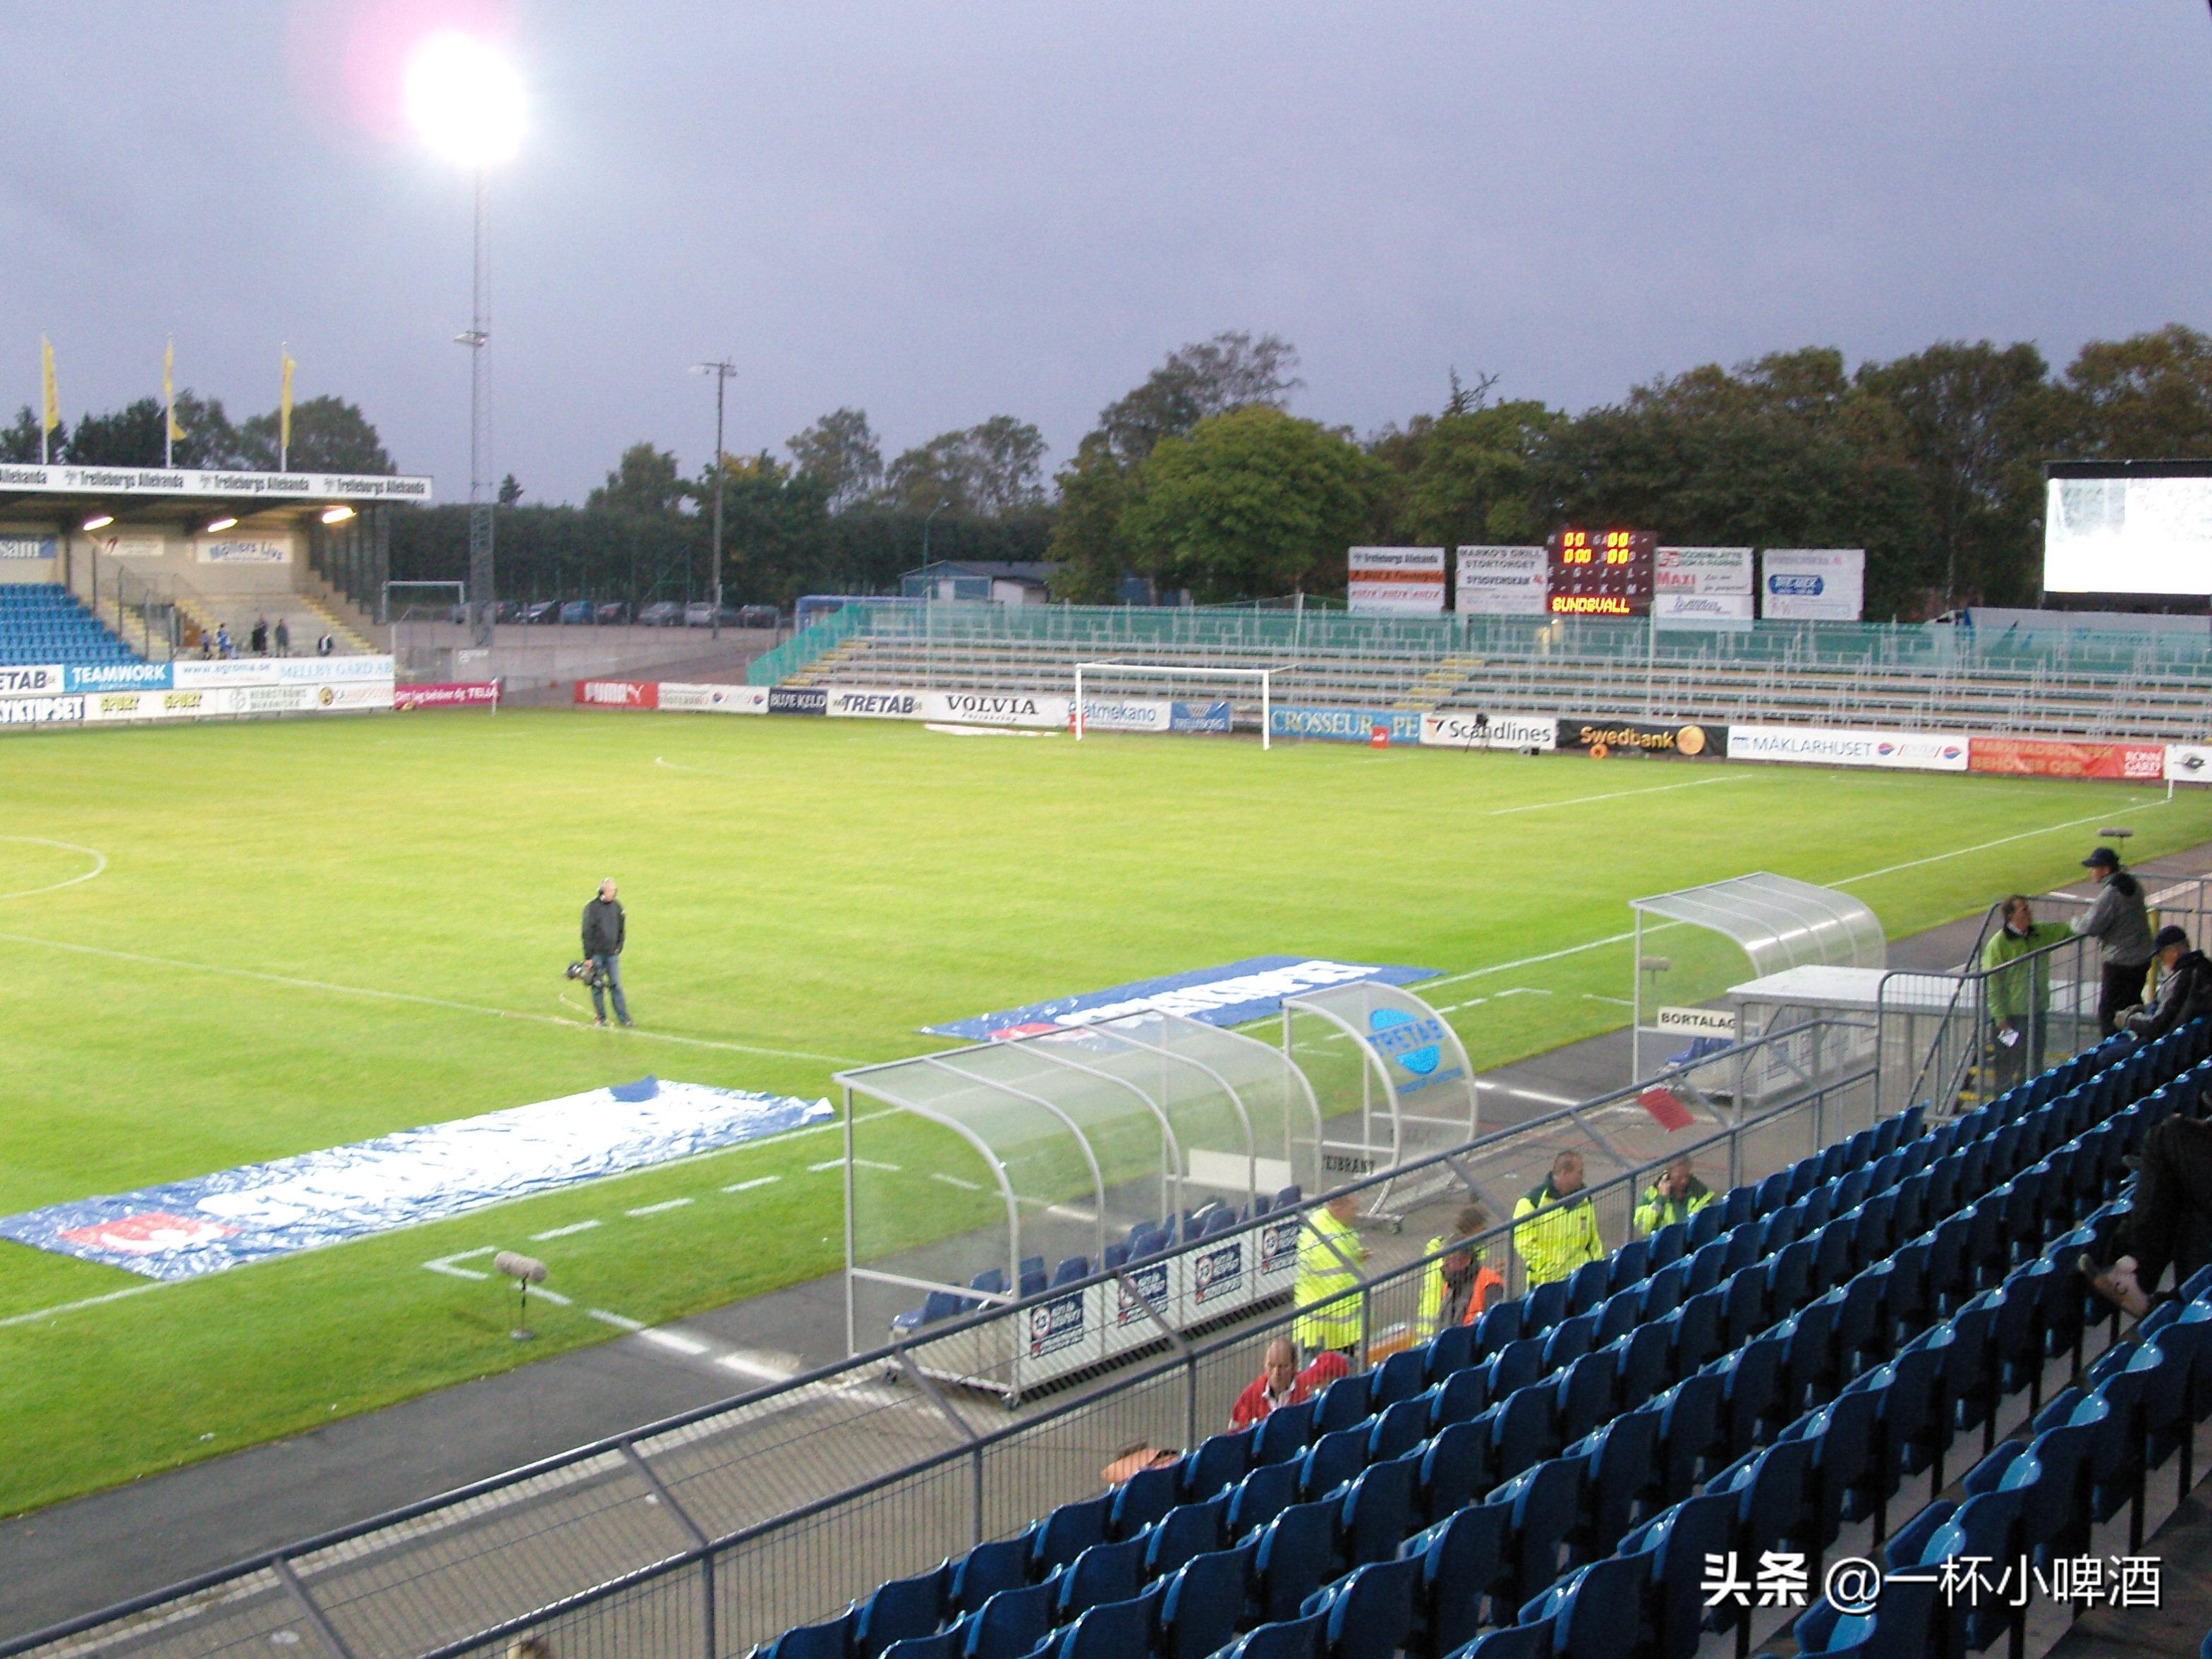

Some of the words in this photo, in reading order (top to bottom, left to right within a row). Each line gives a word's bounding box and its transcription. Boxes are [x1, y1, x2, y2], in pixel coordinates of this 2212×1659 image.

[72, 664, 166, 686] TEAMWORK
[585, 681, 628, 703] PUMA
[844, 693, 915, 713] TRETAB
[0, 696, 84, 723] YKTIPSET
[947, 694, 1040, 715] VOLVIA
[1580, 726, 1675, 748] Swedbank
